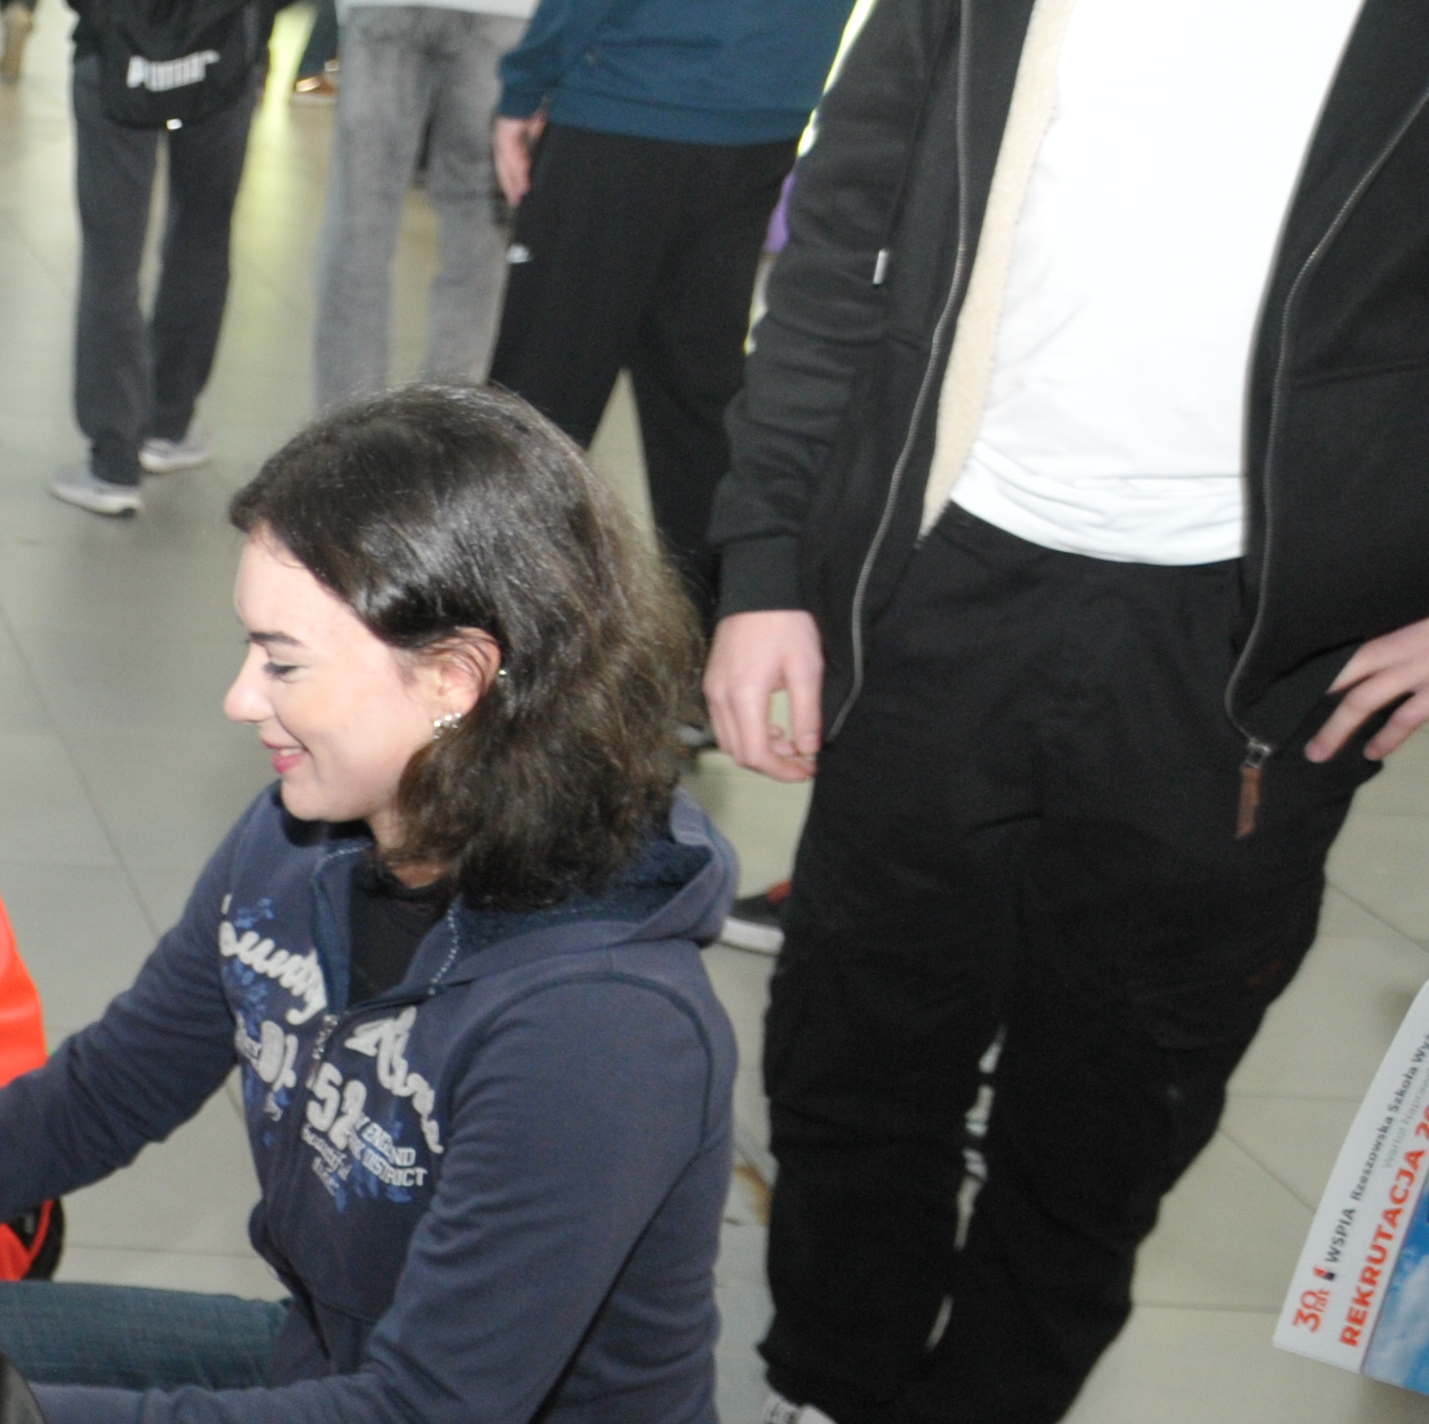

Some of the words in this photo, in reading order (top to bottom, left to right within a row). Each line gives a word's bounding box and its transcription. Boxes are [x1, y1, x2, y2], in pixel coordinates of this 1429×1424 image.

[360, 1147, 429, 1187] DISTRICT
[1325, 1207, 1357, 1264] WSPIA
[1338, 1149, 1427, 1347] REKRUTACJA
